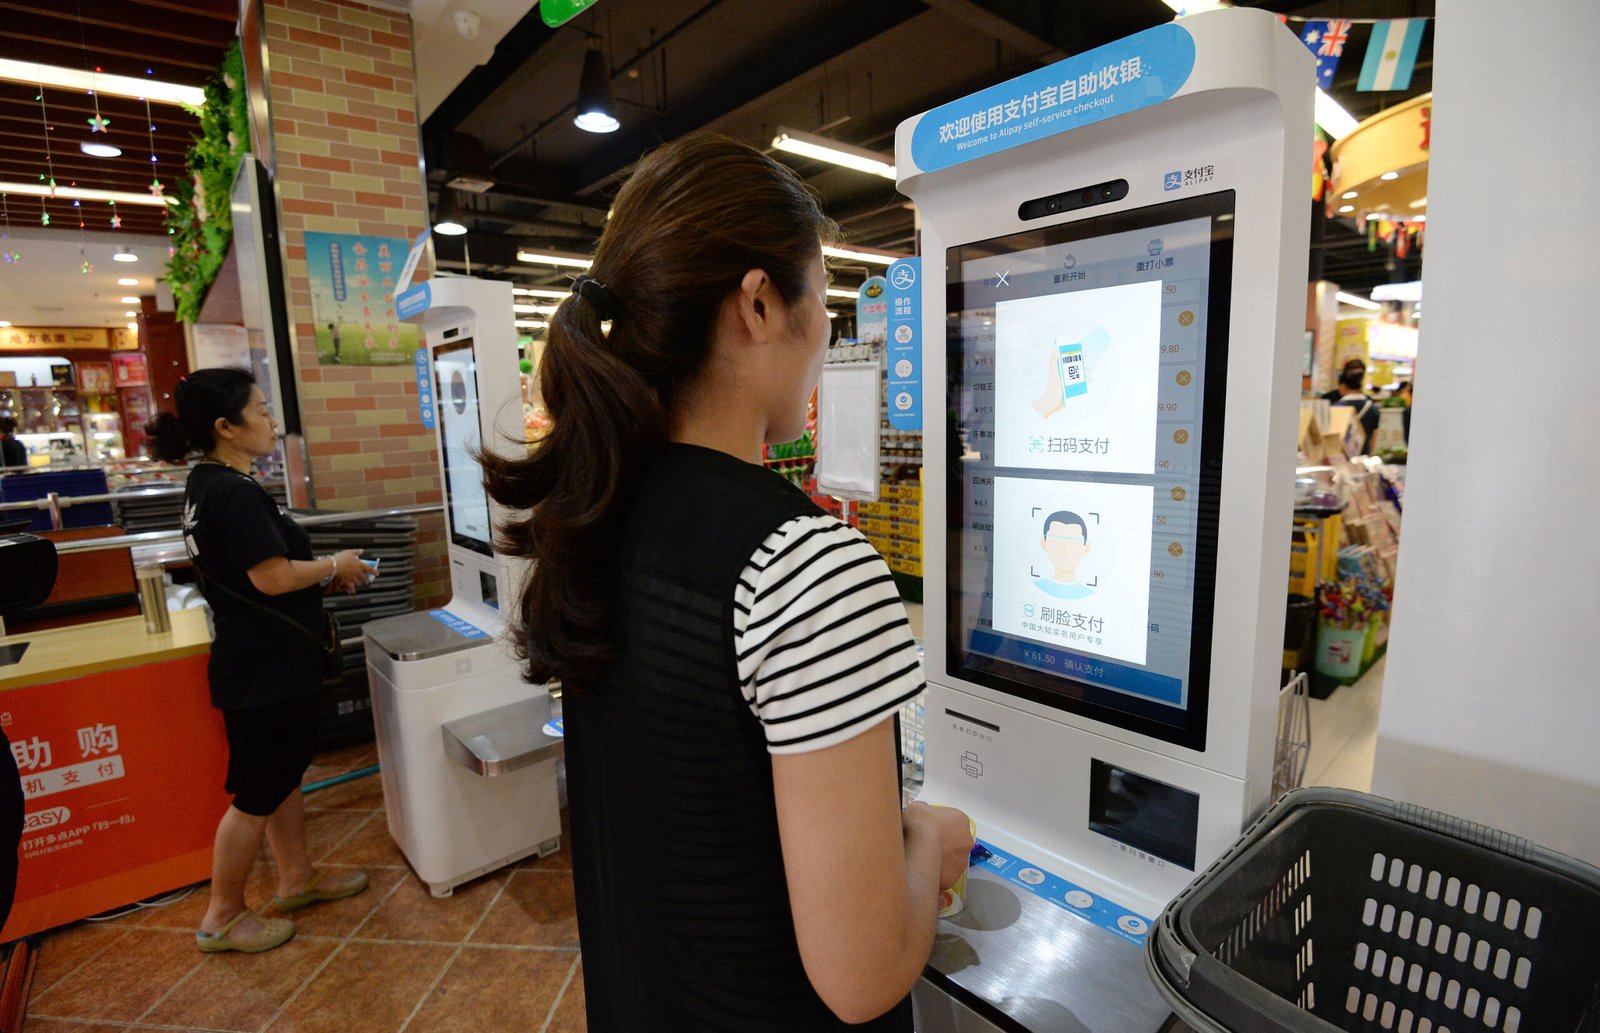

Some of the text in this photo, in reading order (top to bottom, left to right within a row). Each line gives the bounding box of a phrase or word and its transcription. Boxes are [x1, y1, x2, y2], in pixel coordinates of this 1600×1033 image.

[939, 56, 1141, 143] 欢迎使用支付宝自助收银
[957, 94, 1115, 151] Welcome to Alipay self-service checkout
[1184, 165, 1214, 181] 支付宝
[1184, 176, 1213, 186] ALIPAY
[1136, 257, 1174, 271] 重打小票
[1054, 271, 1086, 283] 重新开始
[1048, 437, 1110, 454] 扫码支付
[1040, 606, 1104, 633] 刷脸支付
[1021, 621, 1104, 645] 中国大陆实名用户专享
[1064, 658, 1104, 677] 确认支付
